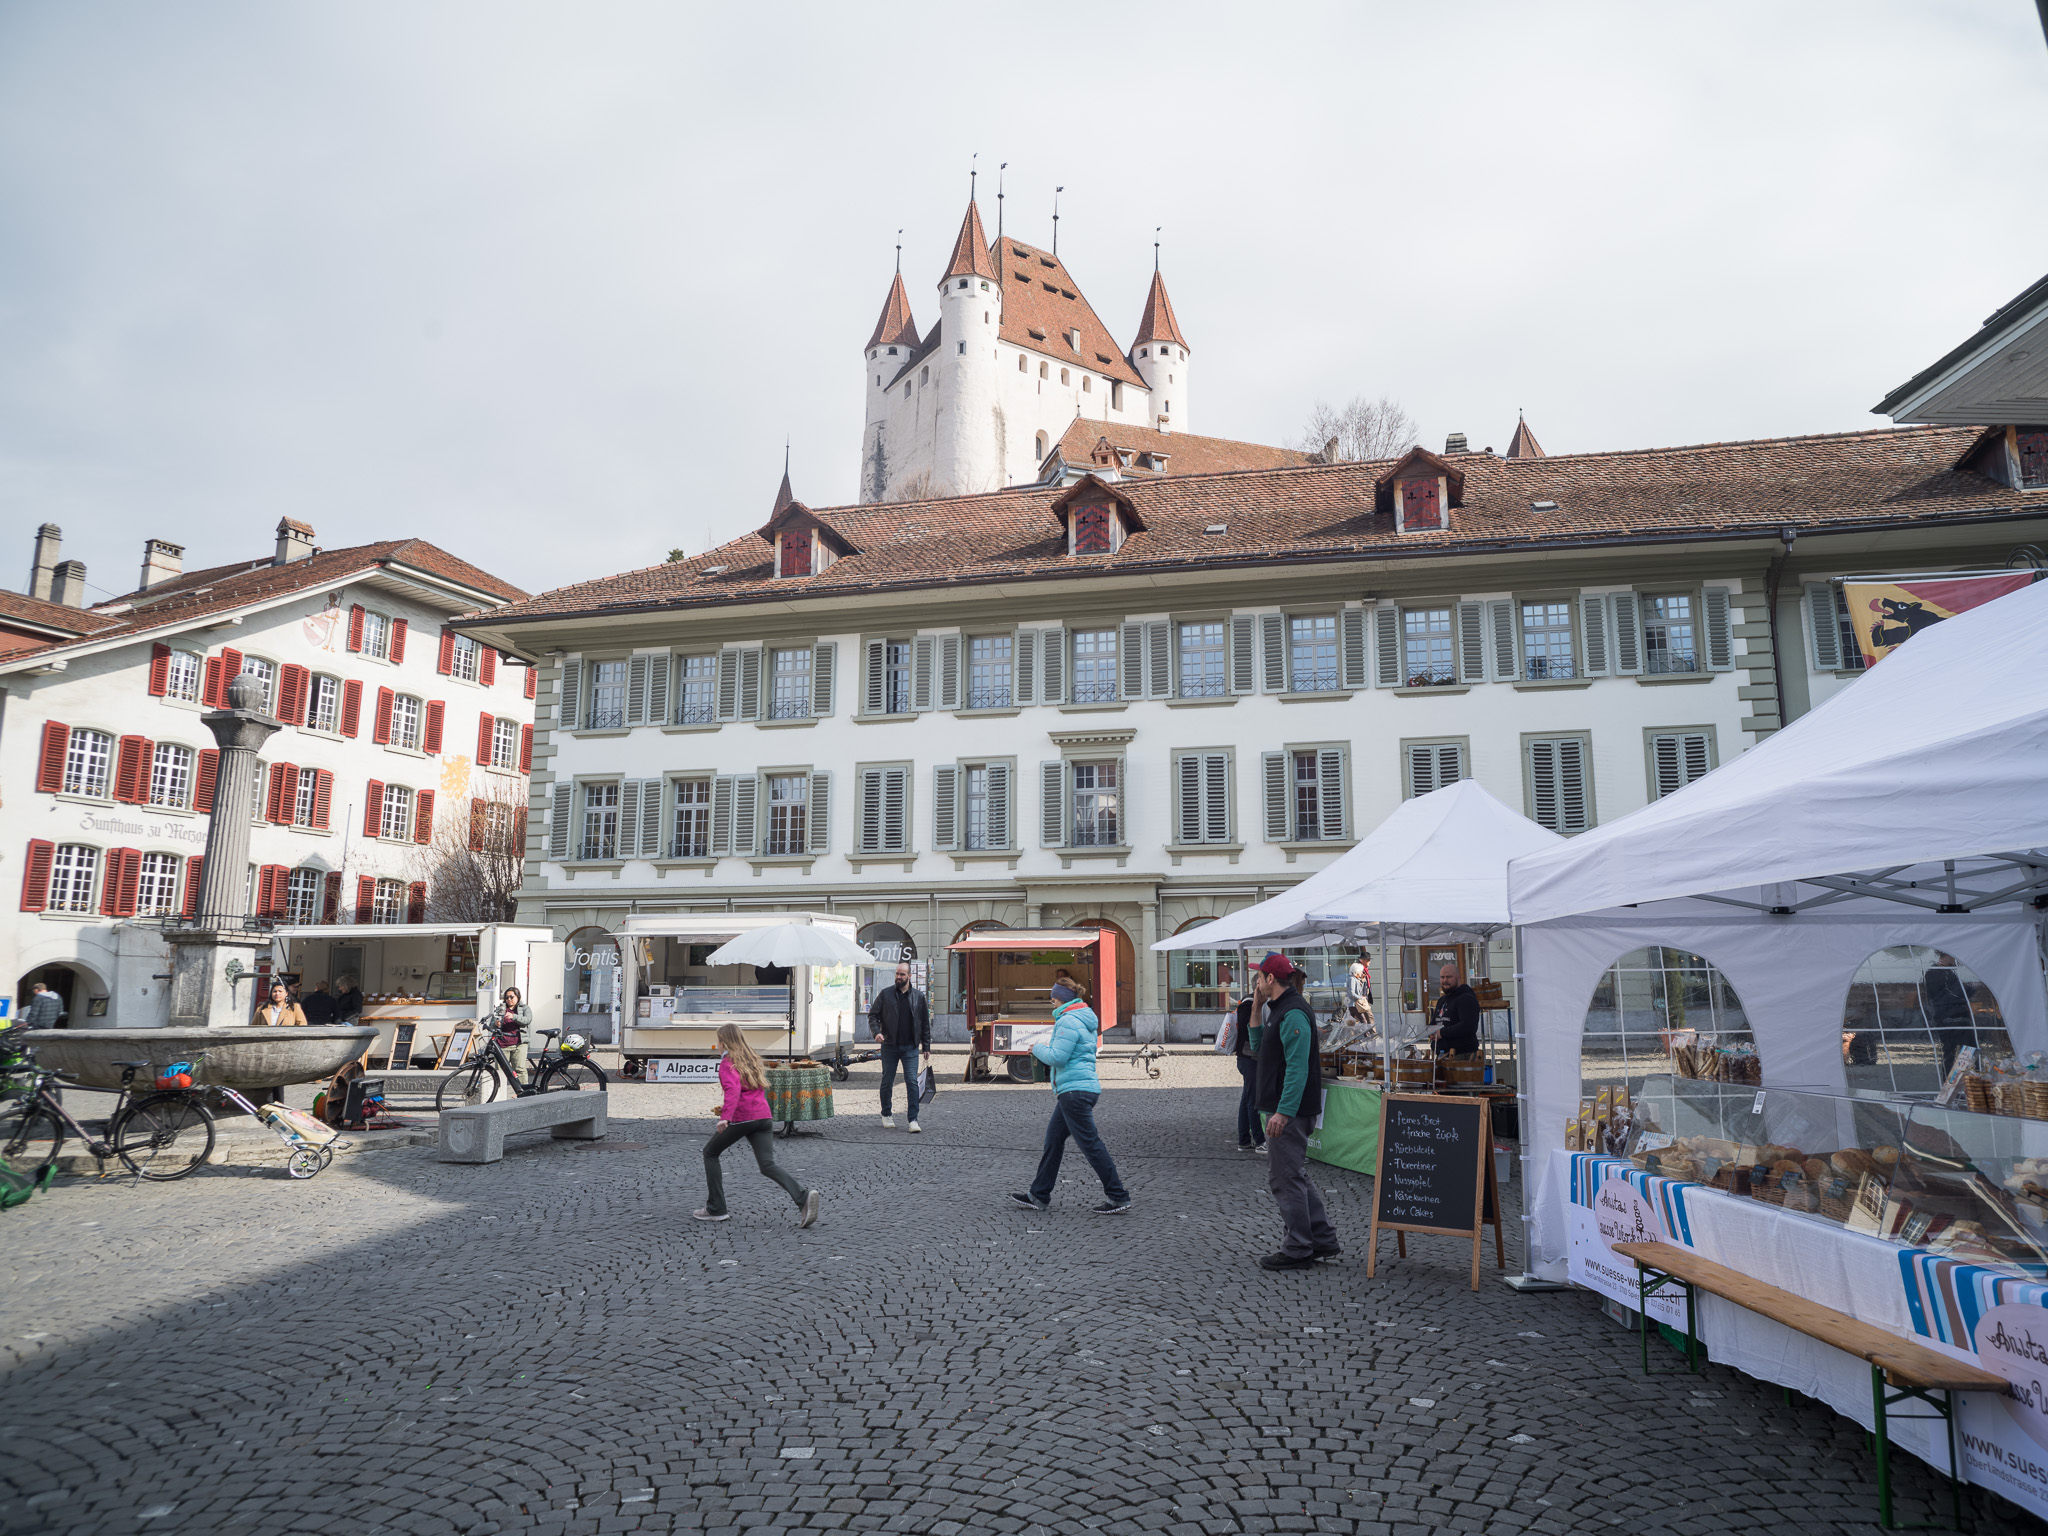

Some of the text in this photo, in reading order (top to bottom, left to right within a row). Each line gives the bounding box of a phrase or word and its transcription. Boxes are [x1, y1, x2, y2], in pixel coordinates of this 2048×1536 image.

[80, 812, 144, 835] Zunfthaus
[147, 825, 161, 838] zu
[564, 947, 620, 971] fontis
[1221, 1022, 1231, 1049] MIGROS
[1421, 1113, 1441, 1126] Brot
[1394, 1158, 1437, 1171] Florentiner
[1410, 1206, 1434, 1219] Cakes
[1600, 1189, 1627, 1214] Anitas
[1961, 1431, 2048, 1485] www.sues
[1966, 1453, 2037, 1497] Oberlandstrasse
